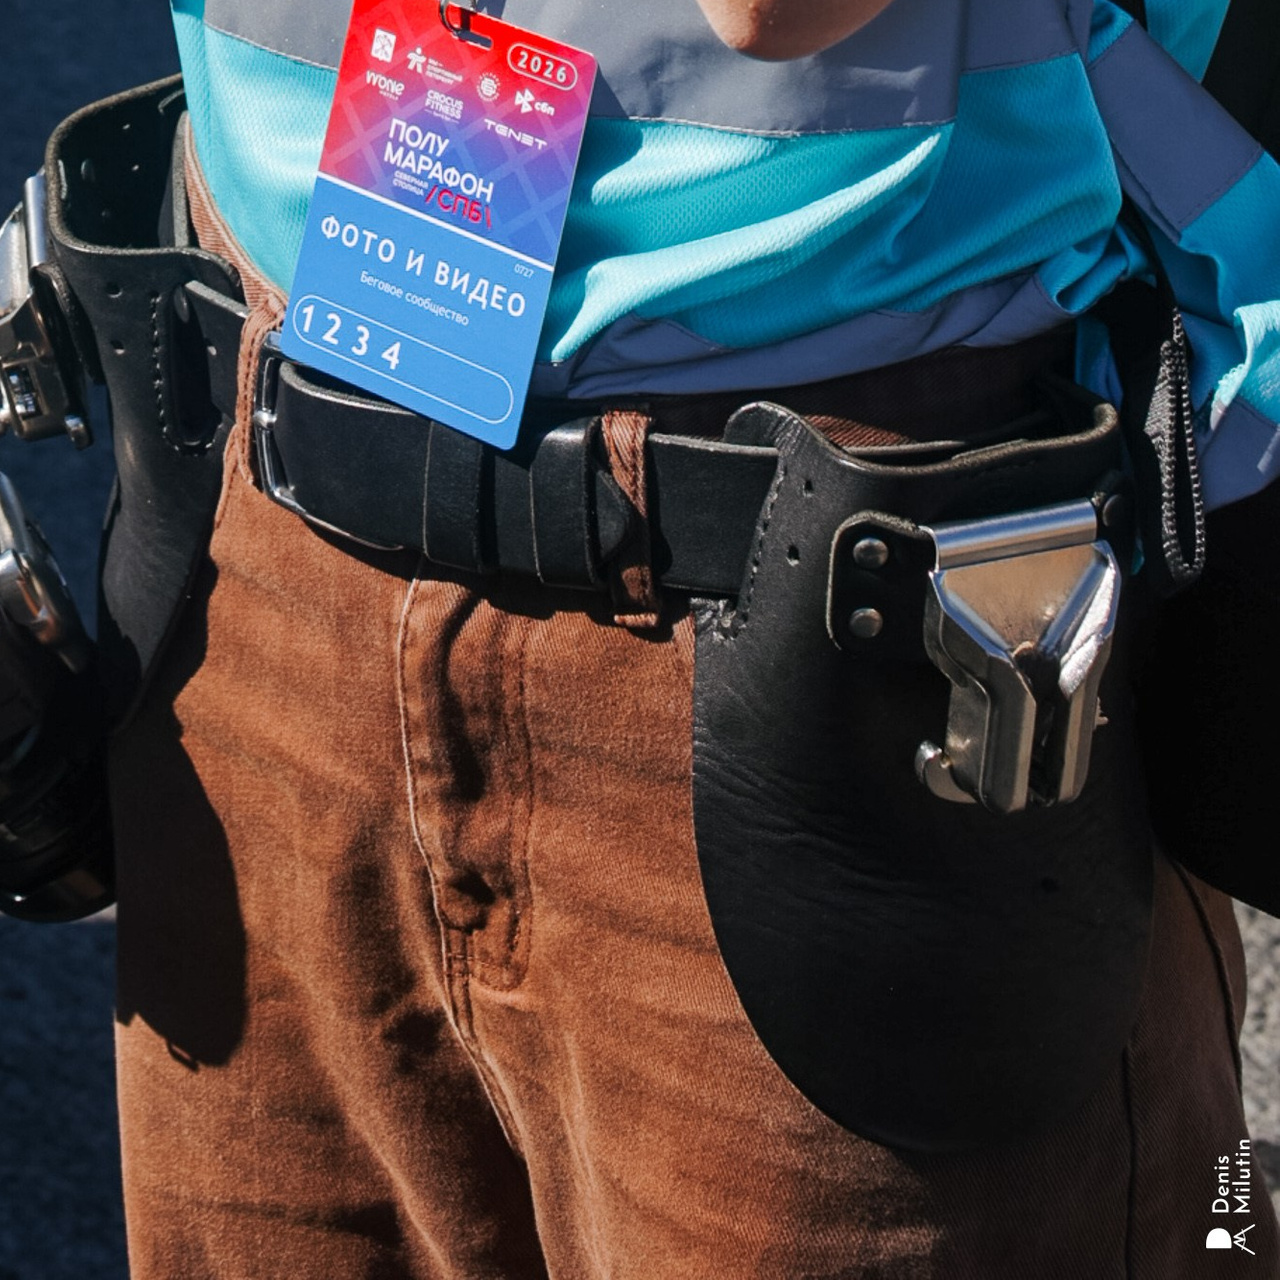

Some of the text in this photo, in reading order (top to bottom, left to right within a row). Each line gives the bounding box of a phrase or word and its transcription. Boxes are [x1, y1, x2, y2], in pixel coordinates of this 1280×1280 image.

[518, 50, 567, 83] 2026
[425, 97, 462, 120] FITNESS
[427, 89, 464, 111] CROCUS
[388, 117, 450, 157] ПОЛУ
[483, 118, 548, 150] TENET
[383, 141, 495, 203] МАРАФОН
[393, 169, 429, 189] СЕВЕРНАЯ
[321, 215, 526, 317] ФОТО И ВИДЕО
[513, 262, 535, 279] 0727
[360, 269, 470, 327] Беговое сообщество
